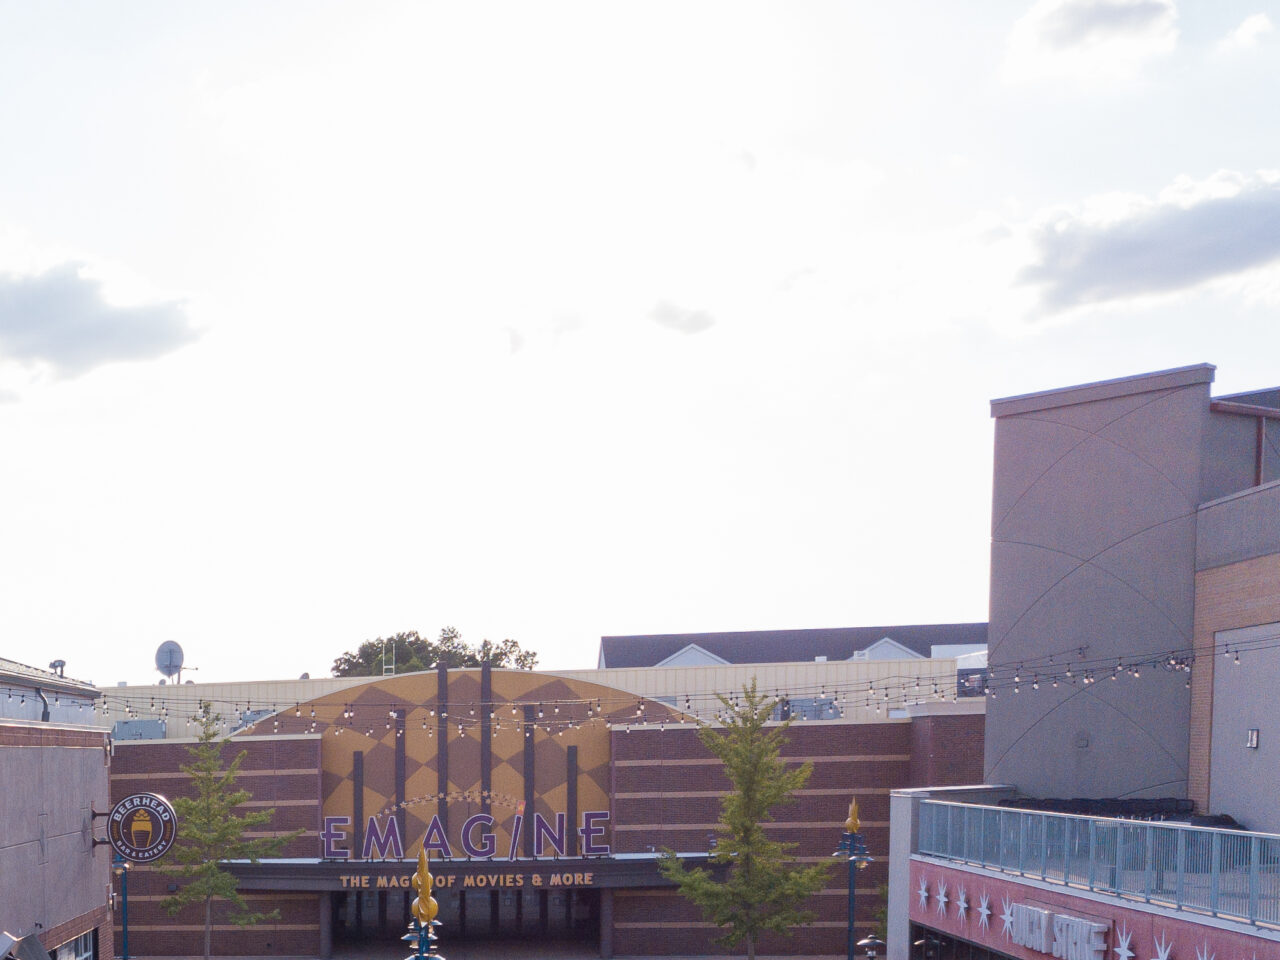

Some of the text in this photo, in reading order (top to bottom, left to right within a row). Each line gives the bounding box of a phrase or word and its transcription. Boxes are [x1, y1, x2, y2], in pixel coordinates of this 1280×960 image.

[113, 797, 170, 821] BEERHEAD
[320, 811, 610, 862] EMAGINE
[117, 840, 131, 855] BAR
[138, 840, 167, 858] EATERY
[339, 872, 594, 888] THE MAG OF MOVIES & MORE
